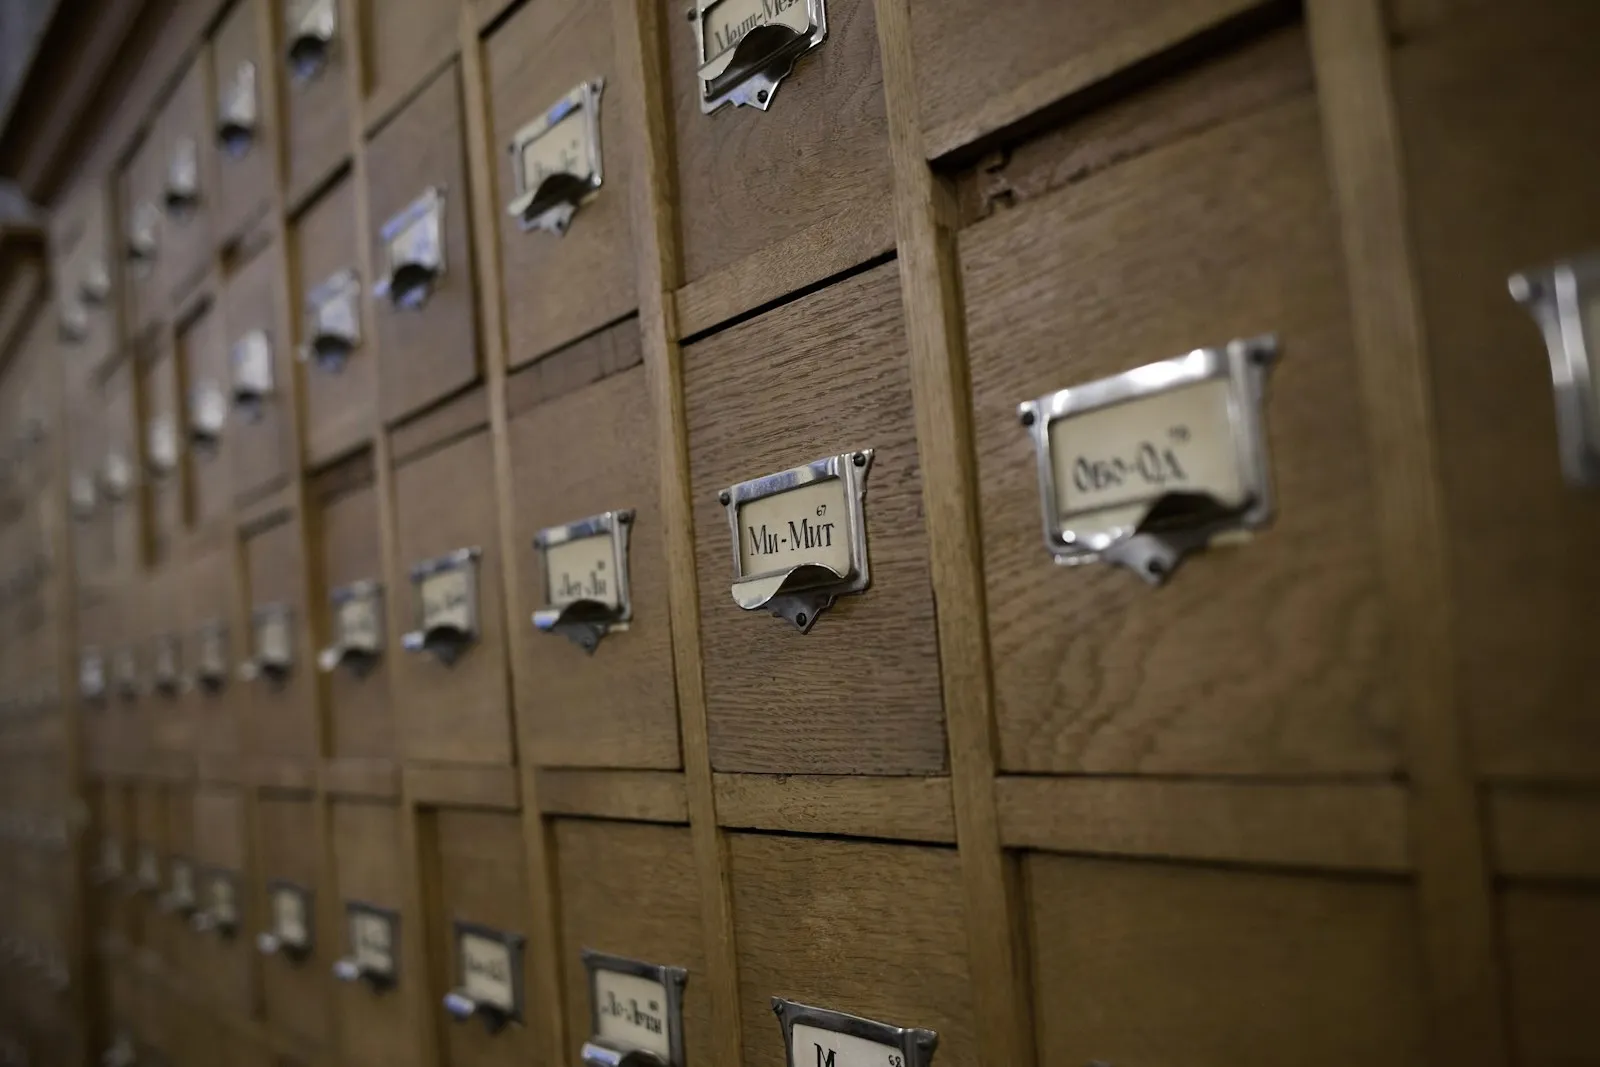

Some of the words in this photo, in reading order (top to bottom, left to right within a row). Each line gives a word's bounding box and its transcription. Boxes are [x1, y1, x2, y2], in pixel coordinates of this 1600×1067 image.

[816, 504, 827, 517] 67
[748, 518, 835, 556] Ми-Мит
[888, 1054, 902, 1067] 68
